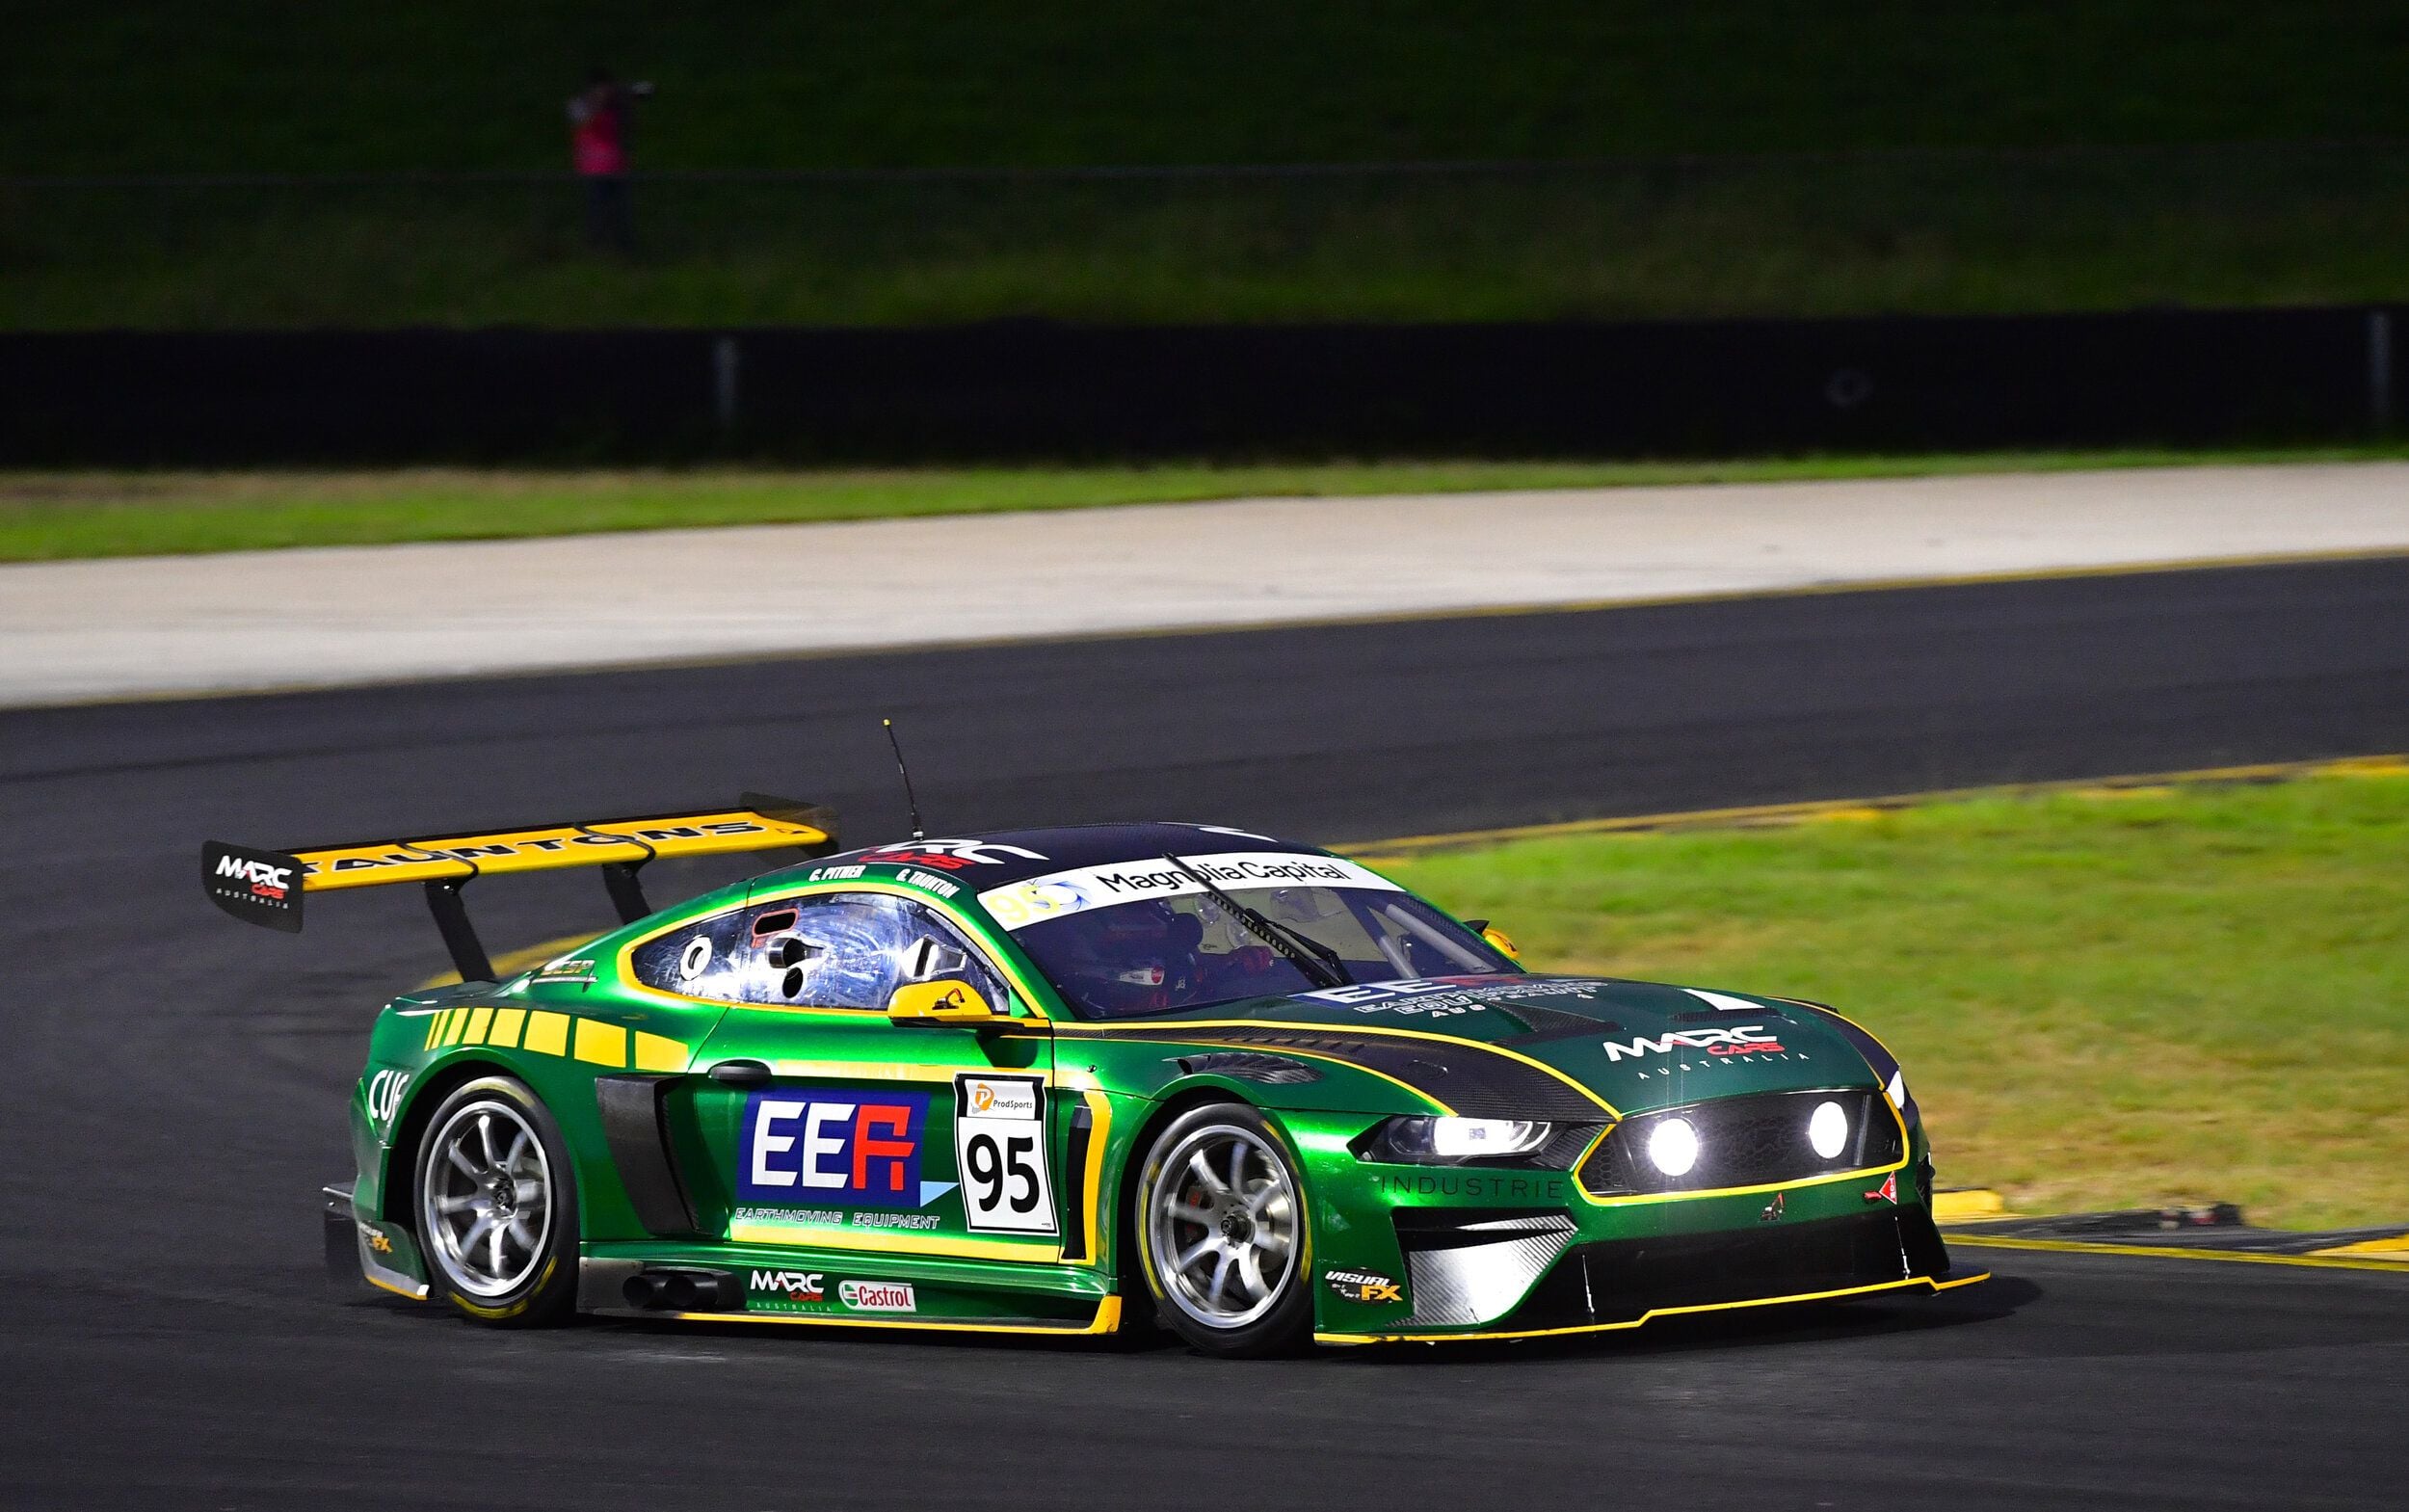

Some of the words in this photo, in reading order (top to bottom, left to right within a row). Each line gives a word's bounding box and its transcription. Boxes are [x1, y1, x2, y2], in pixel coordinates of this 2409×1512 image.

[215, 855, 293, 889] MARC
[1238, 861, 1352, 882] Capital
[908, 870, 961, 898] TAUNTON
[216, 888, 288, 910] AUSTRALIA
[987, 885, 1060, 922] 95
[1602, 1025, 1778, 1062] MARC
[1707, 1042, 1786, 1056] CARS
[1638, 1052, 1810, 1080] AUSTRALIA
[993, 1100, 1033, 1110] ProdSports
[966, 1134, 1040, 1213] 95
[1381, 1176, 1563, 1199] INDUSTRIE
[735, 1207, 843, 1225] EARTHMOVING
[852, 1212, 940, 1230] EQUIPMENT
[750, 1269, 825, 1294] MARC
[1325, 1271, 1390, 1287] VISUAL
[859, 1286, 912, 1307] Castrol
[1361, 1285, 1403, 1301] FX
[755, 1302, 832, 1313] AUSTRALIA
